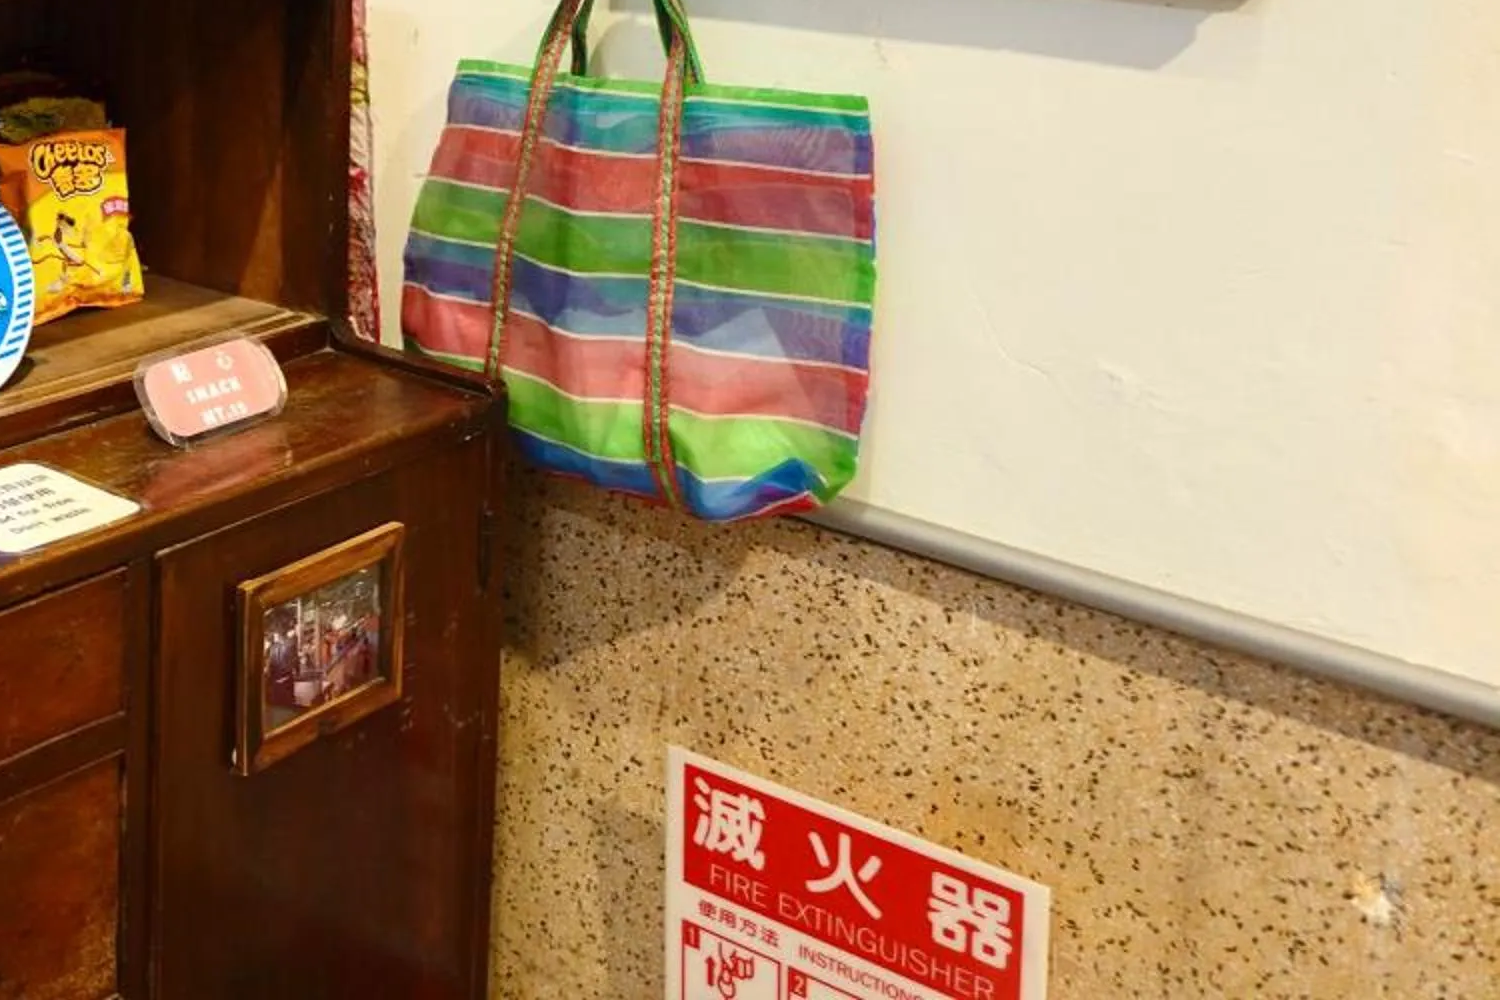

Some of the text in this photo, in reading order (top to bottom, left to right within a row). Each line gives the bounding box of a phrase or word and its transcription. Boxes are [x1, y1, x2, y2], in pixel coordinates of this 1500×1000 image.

[33, 143, 106, 179] Cheetos
[51, 163, 101, 195] 奇多
[693, 777, 1013, 969] 滅火器
[697, 900, 781, 949] 使用方法
[709, 863, 995, 1000] FIRE EXTINGUISHER
